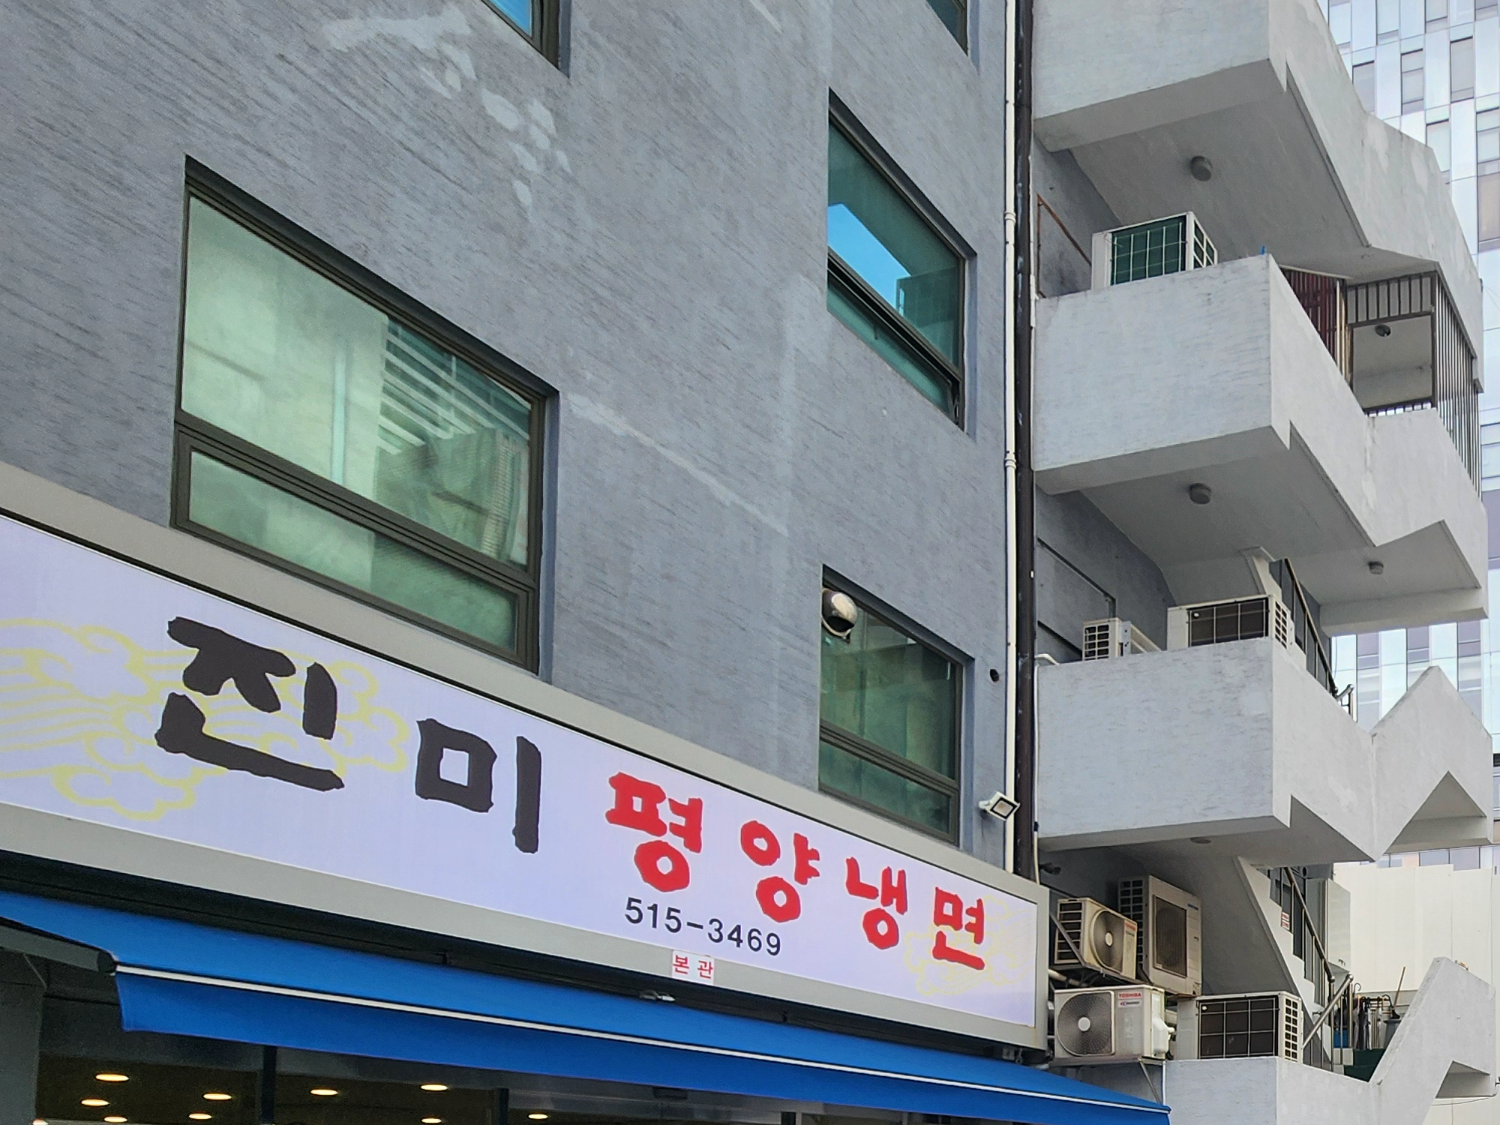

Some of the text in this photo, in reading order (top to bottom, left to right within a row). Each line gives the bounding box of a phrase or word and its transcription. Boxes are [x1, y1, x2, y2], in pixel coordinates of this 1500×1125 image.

[154, 615, 986, 971] 진미 평양냉면
[625, 896, 782, 956] 515-3469
